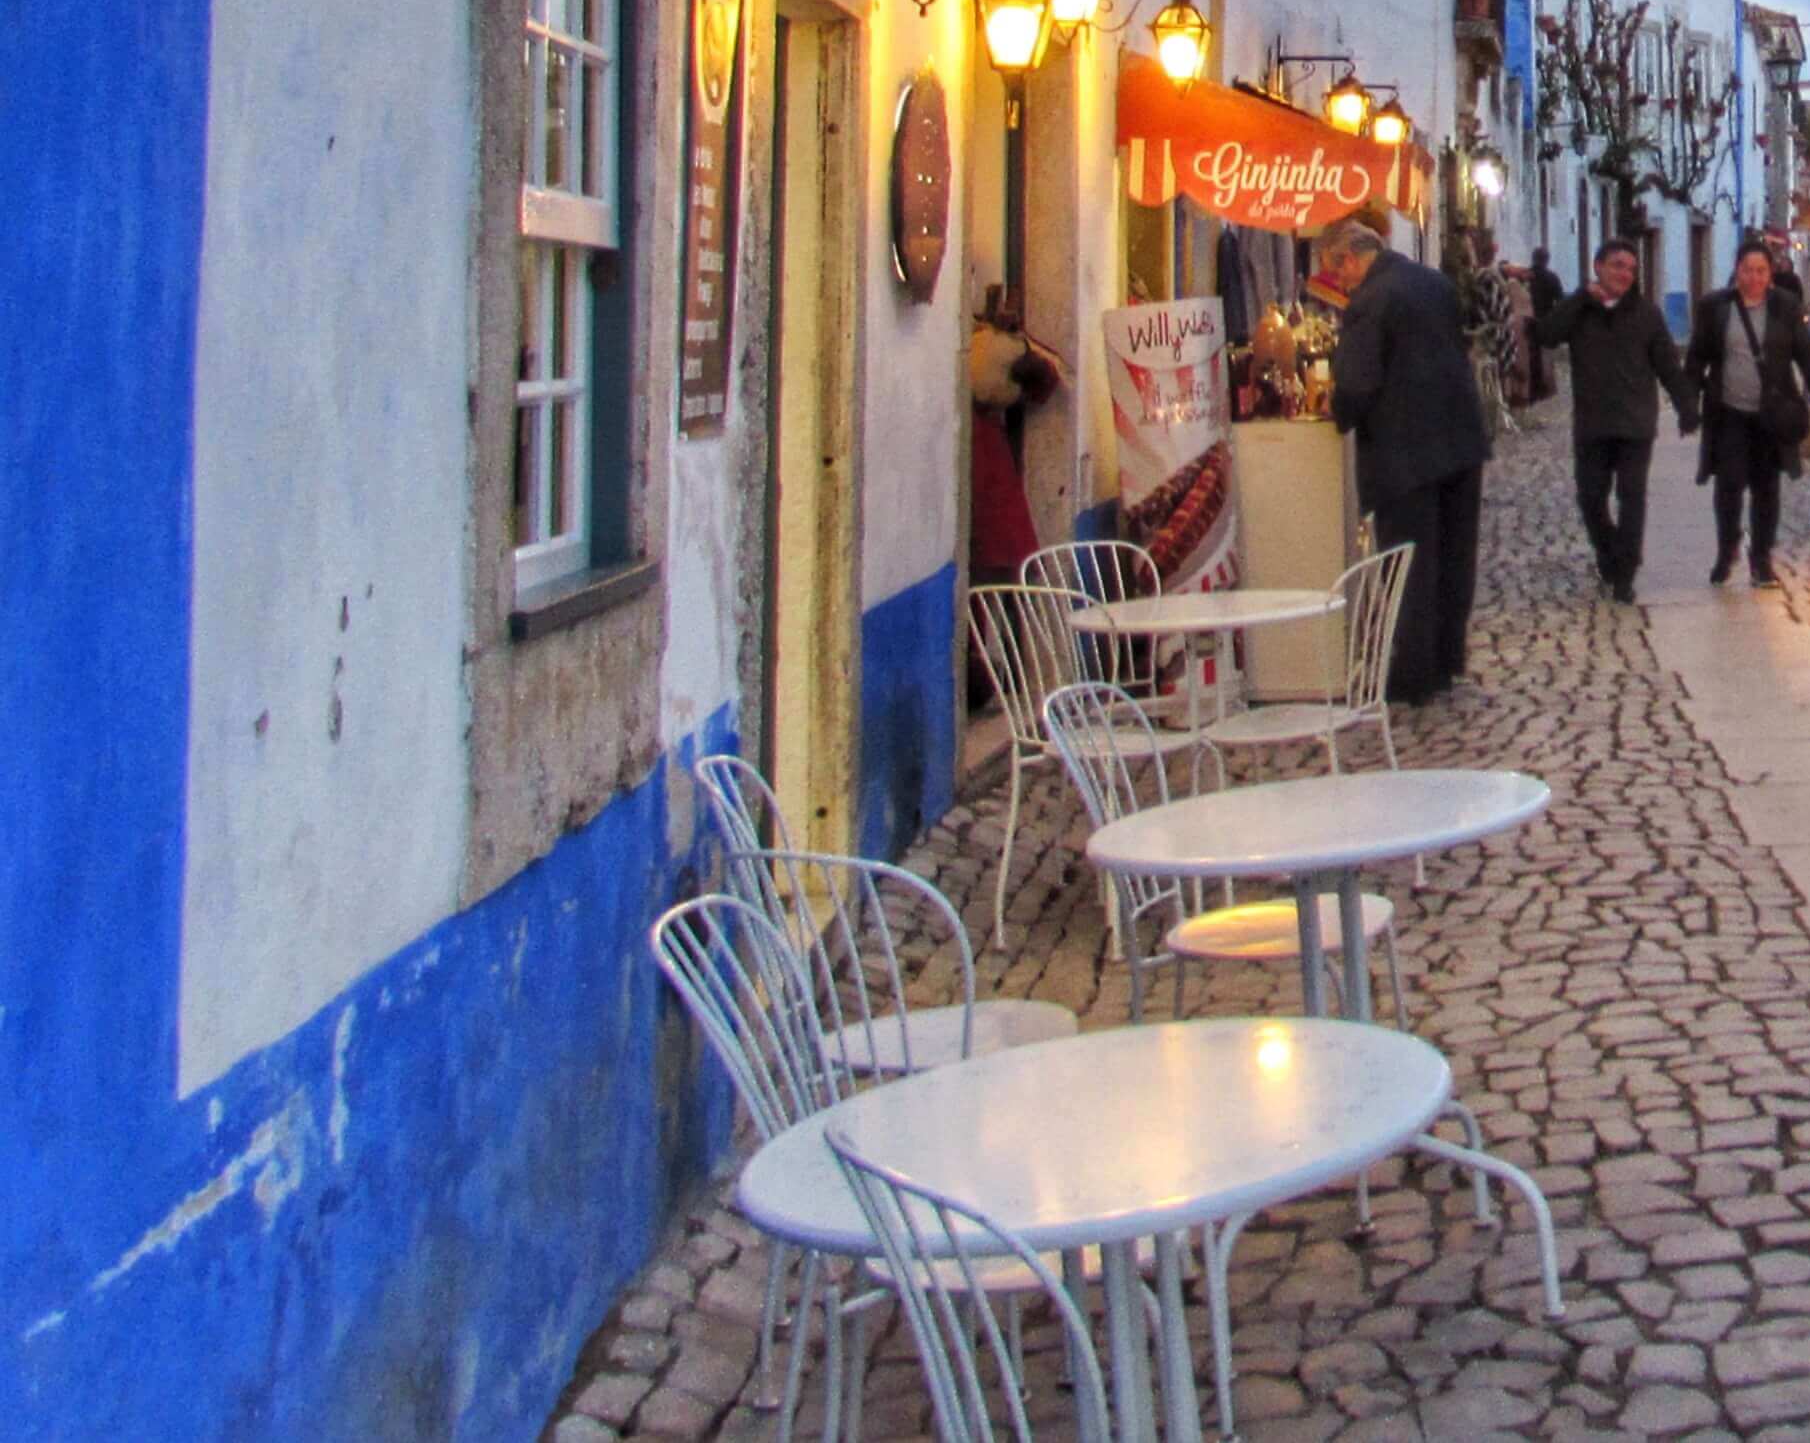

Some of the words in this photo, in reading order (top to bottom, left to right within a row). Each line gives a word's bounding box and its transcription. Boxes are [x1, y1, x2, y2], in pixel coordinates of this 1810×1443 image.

[1193, 141, 1371, 208] Ginjinha
[1294, 193, 1315, 226] 7
[1127, 311, 1183, 363] Willy
